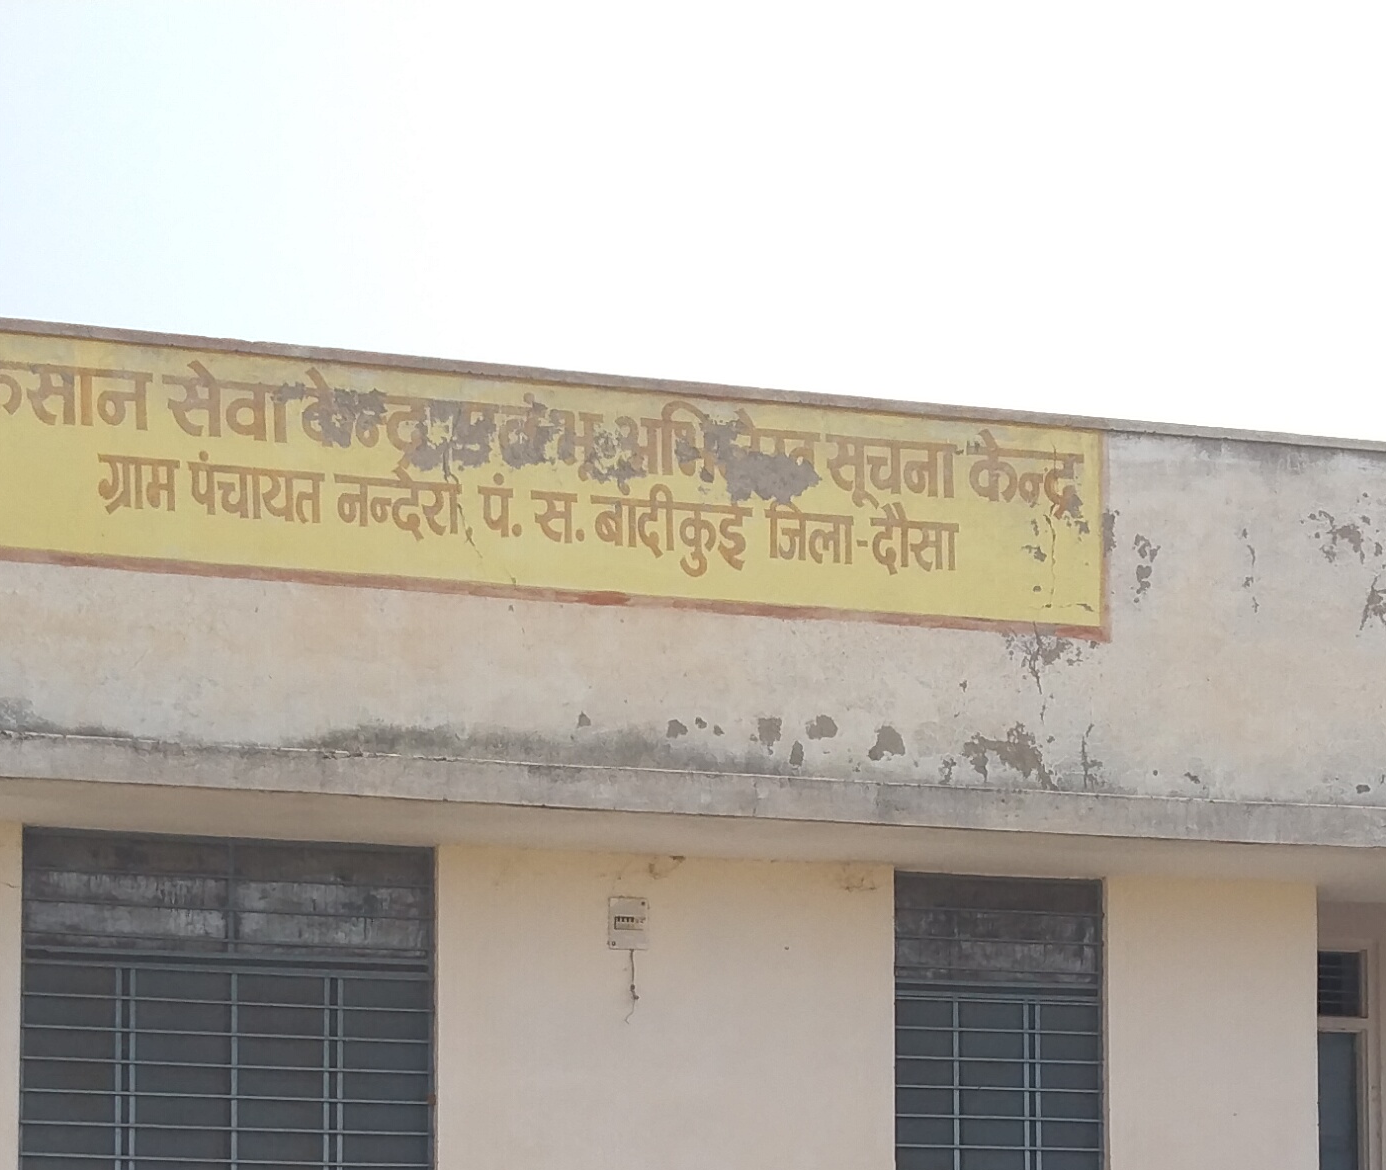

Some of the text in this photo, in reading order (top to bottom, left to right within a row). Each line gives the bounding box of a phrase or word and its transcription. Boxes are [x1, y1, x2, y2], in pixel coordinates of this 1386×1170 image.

[97, 452, 181, 516] ग्राम
[187, 450, 325, 524] पंचायत
[162, 360, 291, 443] सेवा
[826, 433, 958, 509] सूचना
